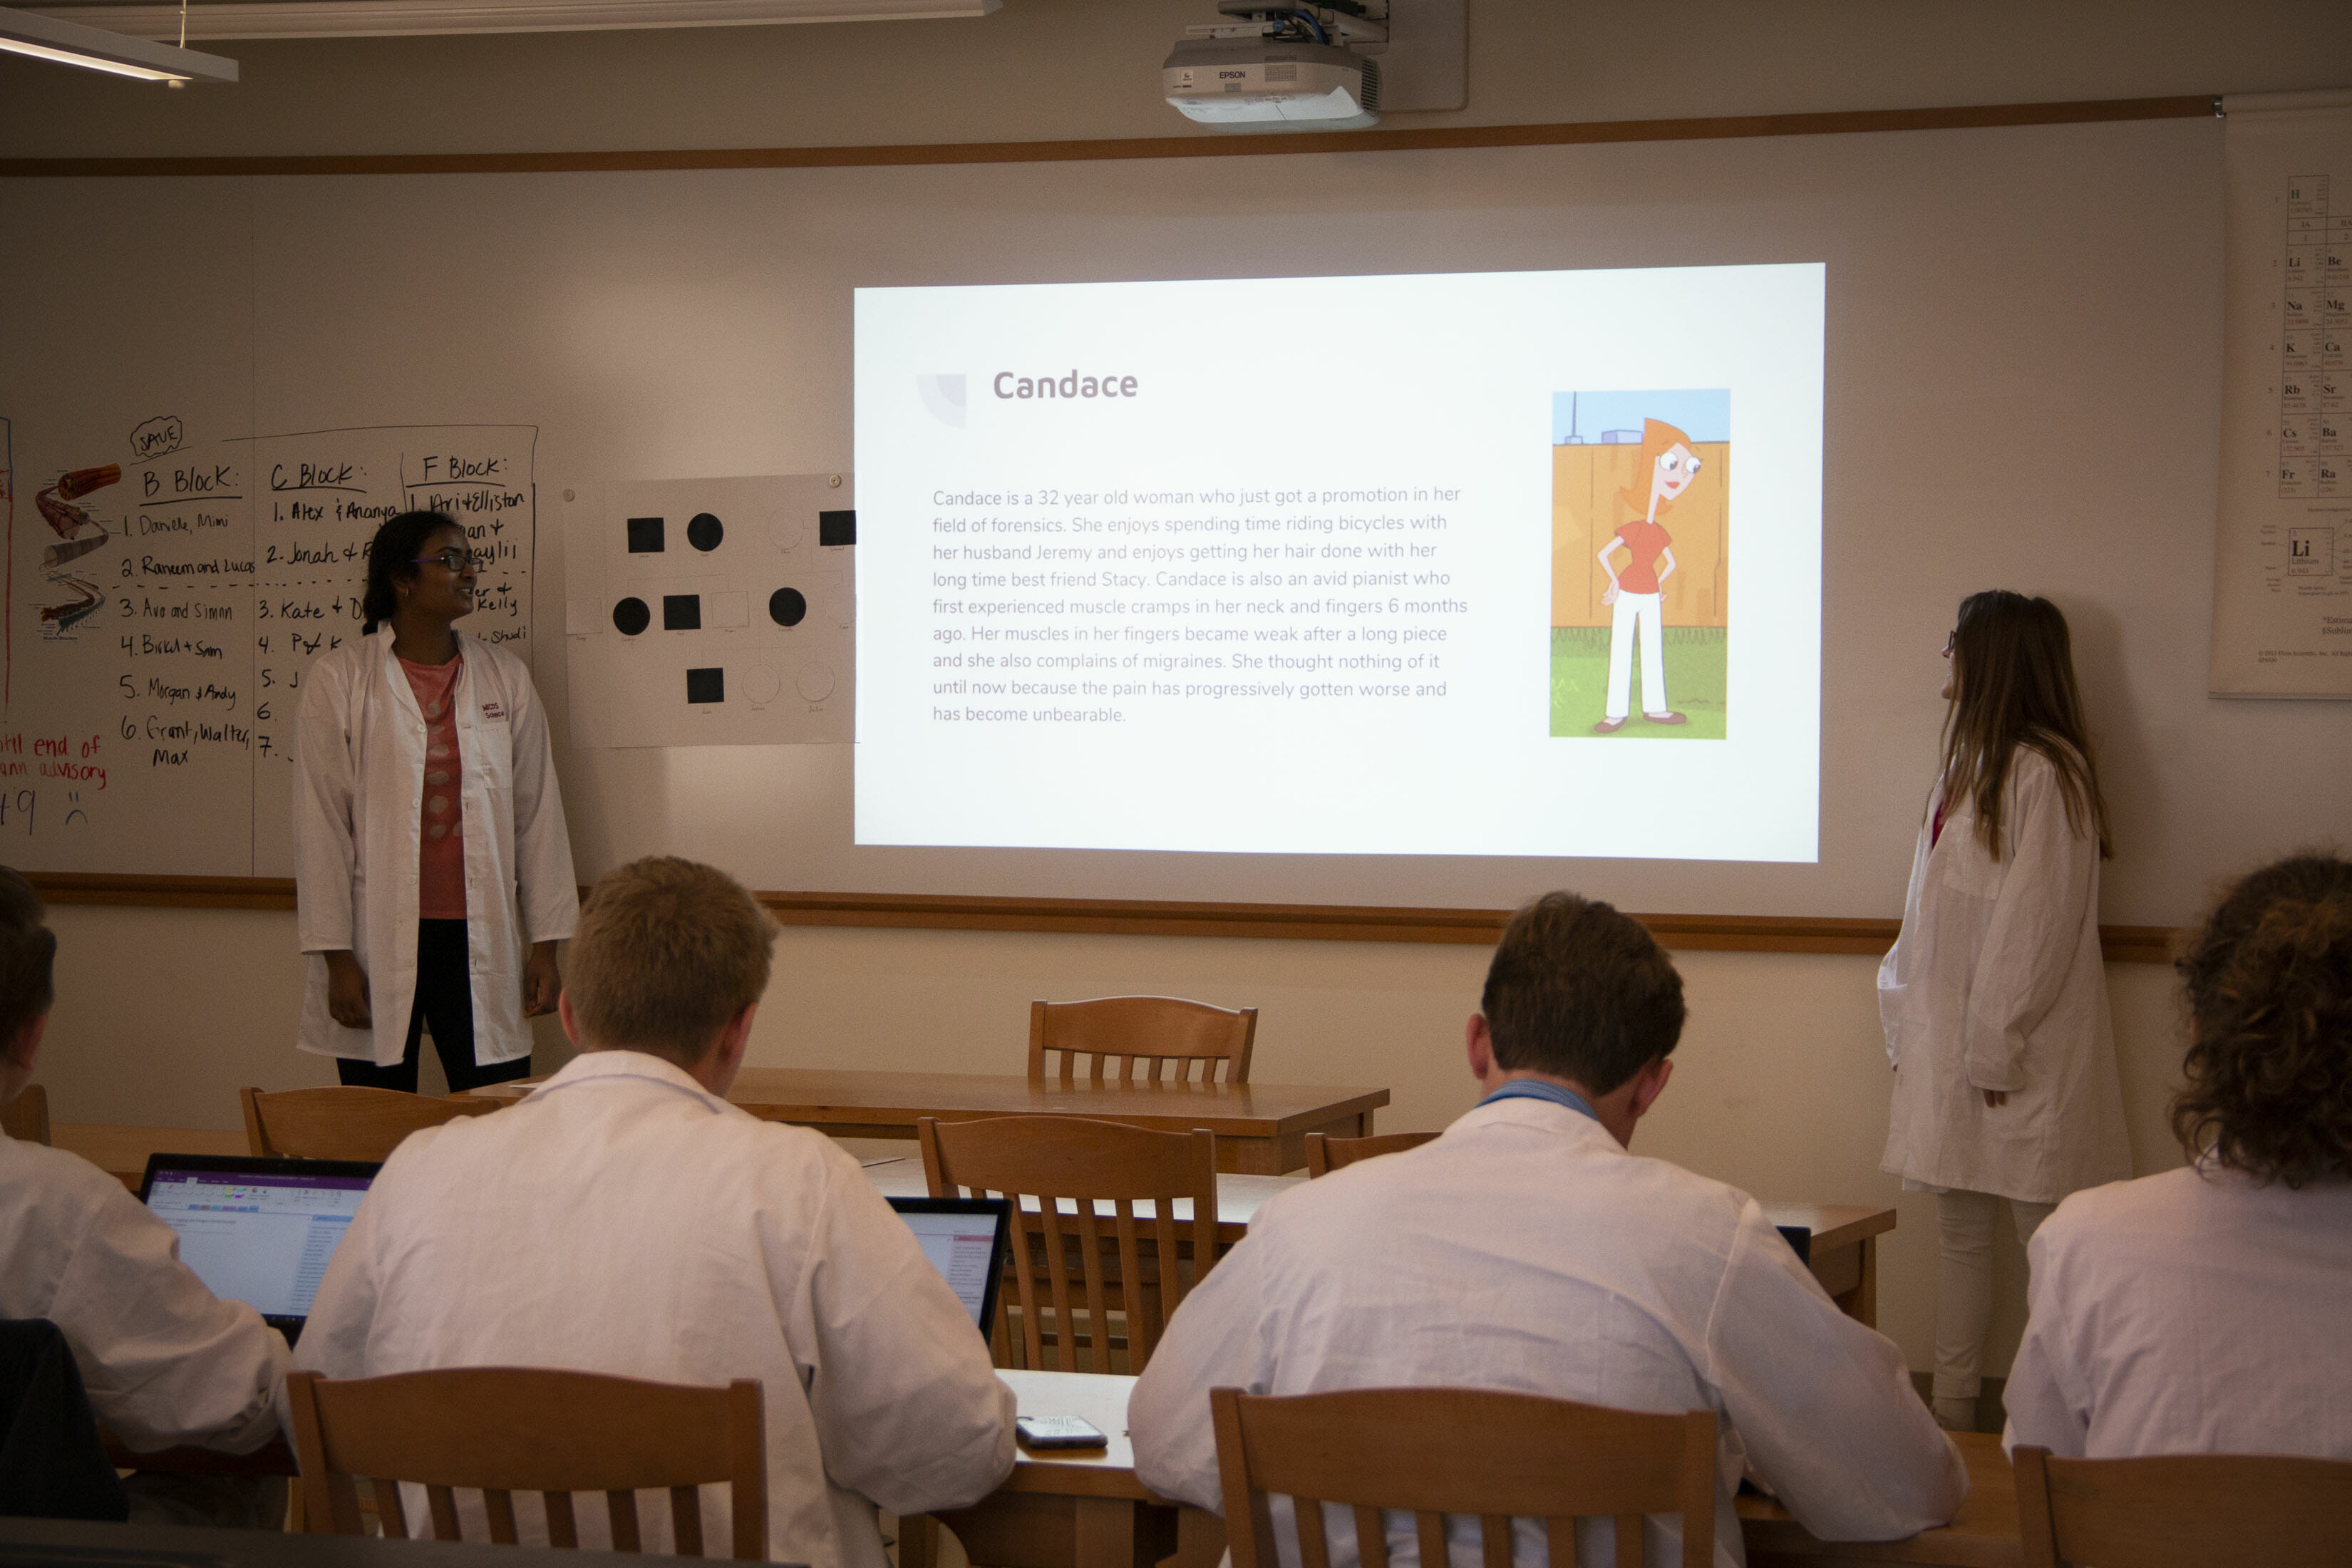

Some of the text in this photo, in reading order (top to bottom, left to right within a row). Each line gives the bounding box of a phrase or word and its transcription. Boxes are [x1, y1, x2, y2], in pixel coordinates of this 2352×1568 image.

[2289, 256, 2343, 267] Li Be
[2287, 299, 2345, 312] Na Mg
[2286, 342, 2341, 353] K Ca
[993, 368, 1139, 401] Candace
[2284, 384, 2337, 395] Rb Sr
[140, 425, 177, 451] SAVE
[2283, 427, 2337, 438] Cs Ba
[272, 464, 287, 489] C
[423, 455, 507, 482] F Block:
[2281, 469, 2336, 479] Fr Ra
[144, 465, 239, 497] B Block:
[933, 486, 1461, 508] Candace is a 32 year old woman who just got a promotion in her
[292, 501, 324, 521] Alex
[932, 514, 1447, 535] field of forensics. She enjoys spending time riding bicycles with
[267, 542, 339, 564] 2. Jonah
[933, 542, 1438, 562] her husband Jeremy and enjoys getting her hair done with her
[2291, 540, 2310, 557] Li
[121, 558, 138, 577] 2.
[197, 559, 220, 574] and
[225, 558, 256, 574] Lucas
[933, 569, 1450, 591] long time best friend Stacy. Candace is also an avid pianist who
[119, 598, 138, 617] 3.
[171, 602, 189, 619] and
[259, 598, 325, 619] 3. Kate
[478, 597, 517, 617] Kelly
[932, 597, 1468, 617] first experienced muscle cramps in her neck and fingers 6 months
[932, 625, 1448, 645] ago. Her muscles in her fingers became weak after a long piece
[195, 640, 223, 659] Sam
[932, 652, 1440, 673] and she also complains of migraines. She thought nothing of it
[119, 674, 236, 711] 5. Morgan Andy
[933, 679, 1447, 700] until now because the pain has progressively gotten worse and
[933, 706, 1126, 723] has become unbearable.
[33, 734, 101, 758] end of
[153, 748, 188, 767] Max
[39, 760, 107, 790] advisory
